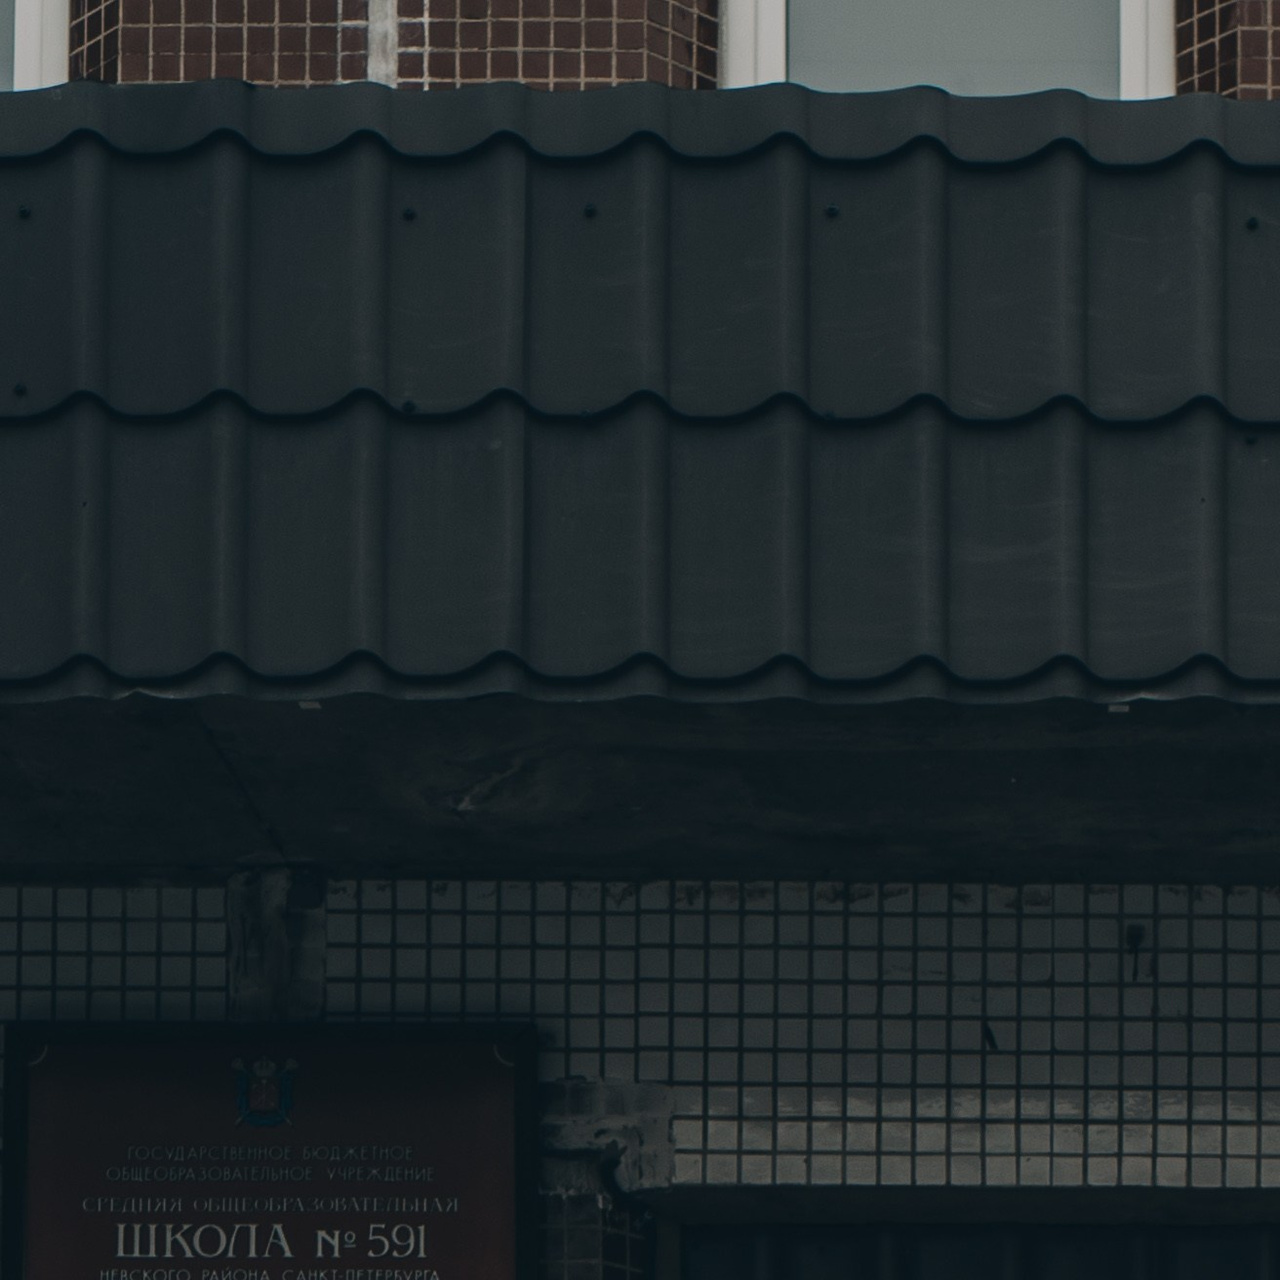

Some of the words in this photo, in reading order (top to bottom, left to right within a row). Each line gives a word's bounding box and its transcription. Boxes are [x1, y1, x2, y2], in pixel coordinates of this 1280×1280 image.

[127, 1145, 294, 1161] ГОСУДАРСТВЕННОЕ
[302, 1145, 414, 1161] БЮДЖЕТНОЕ
[105, 1166, 312, 1182] ОБЩЕОБРАЗОВАТЕЛЬНОЕ
[327, 1166, 435, 1182] УЧРЕЖДЕНИЕ
[82, 1196, 183, 1213] СРЕДНЯЯ
[192, 1196, 458, 1213] ОБЩЕОБРАЗОВАТЕЛЬНАЯ
[116, 1222, 294, 1258] ШКОЛА
[367, 1222, 427, 1258] 591
